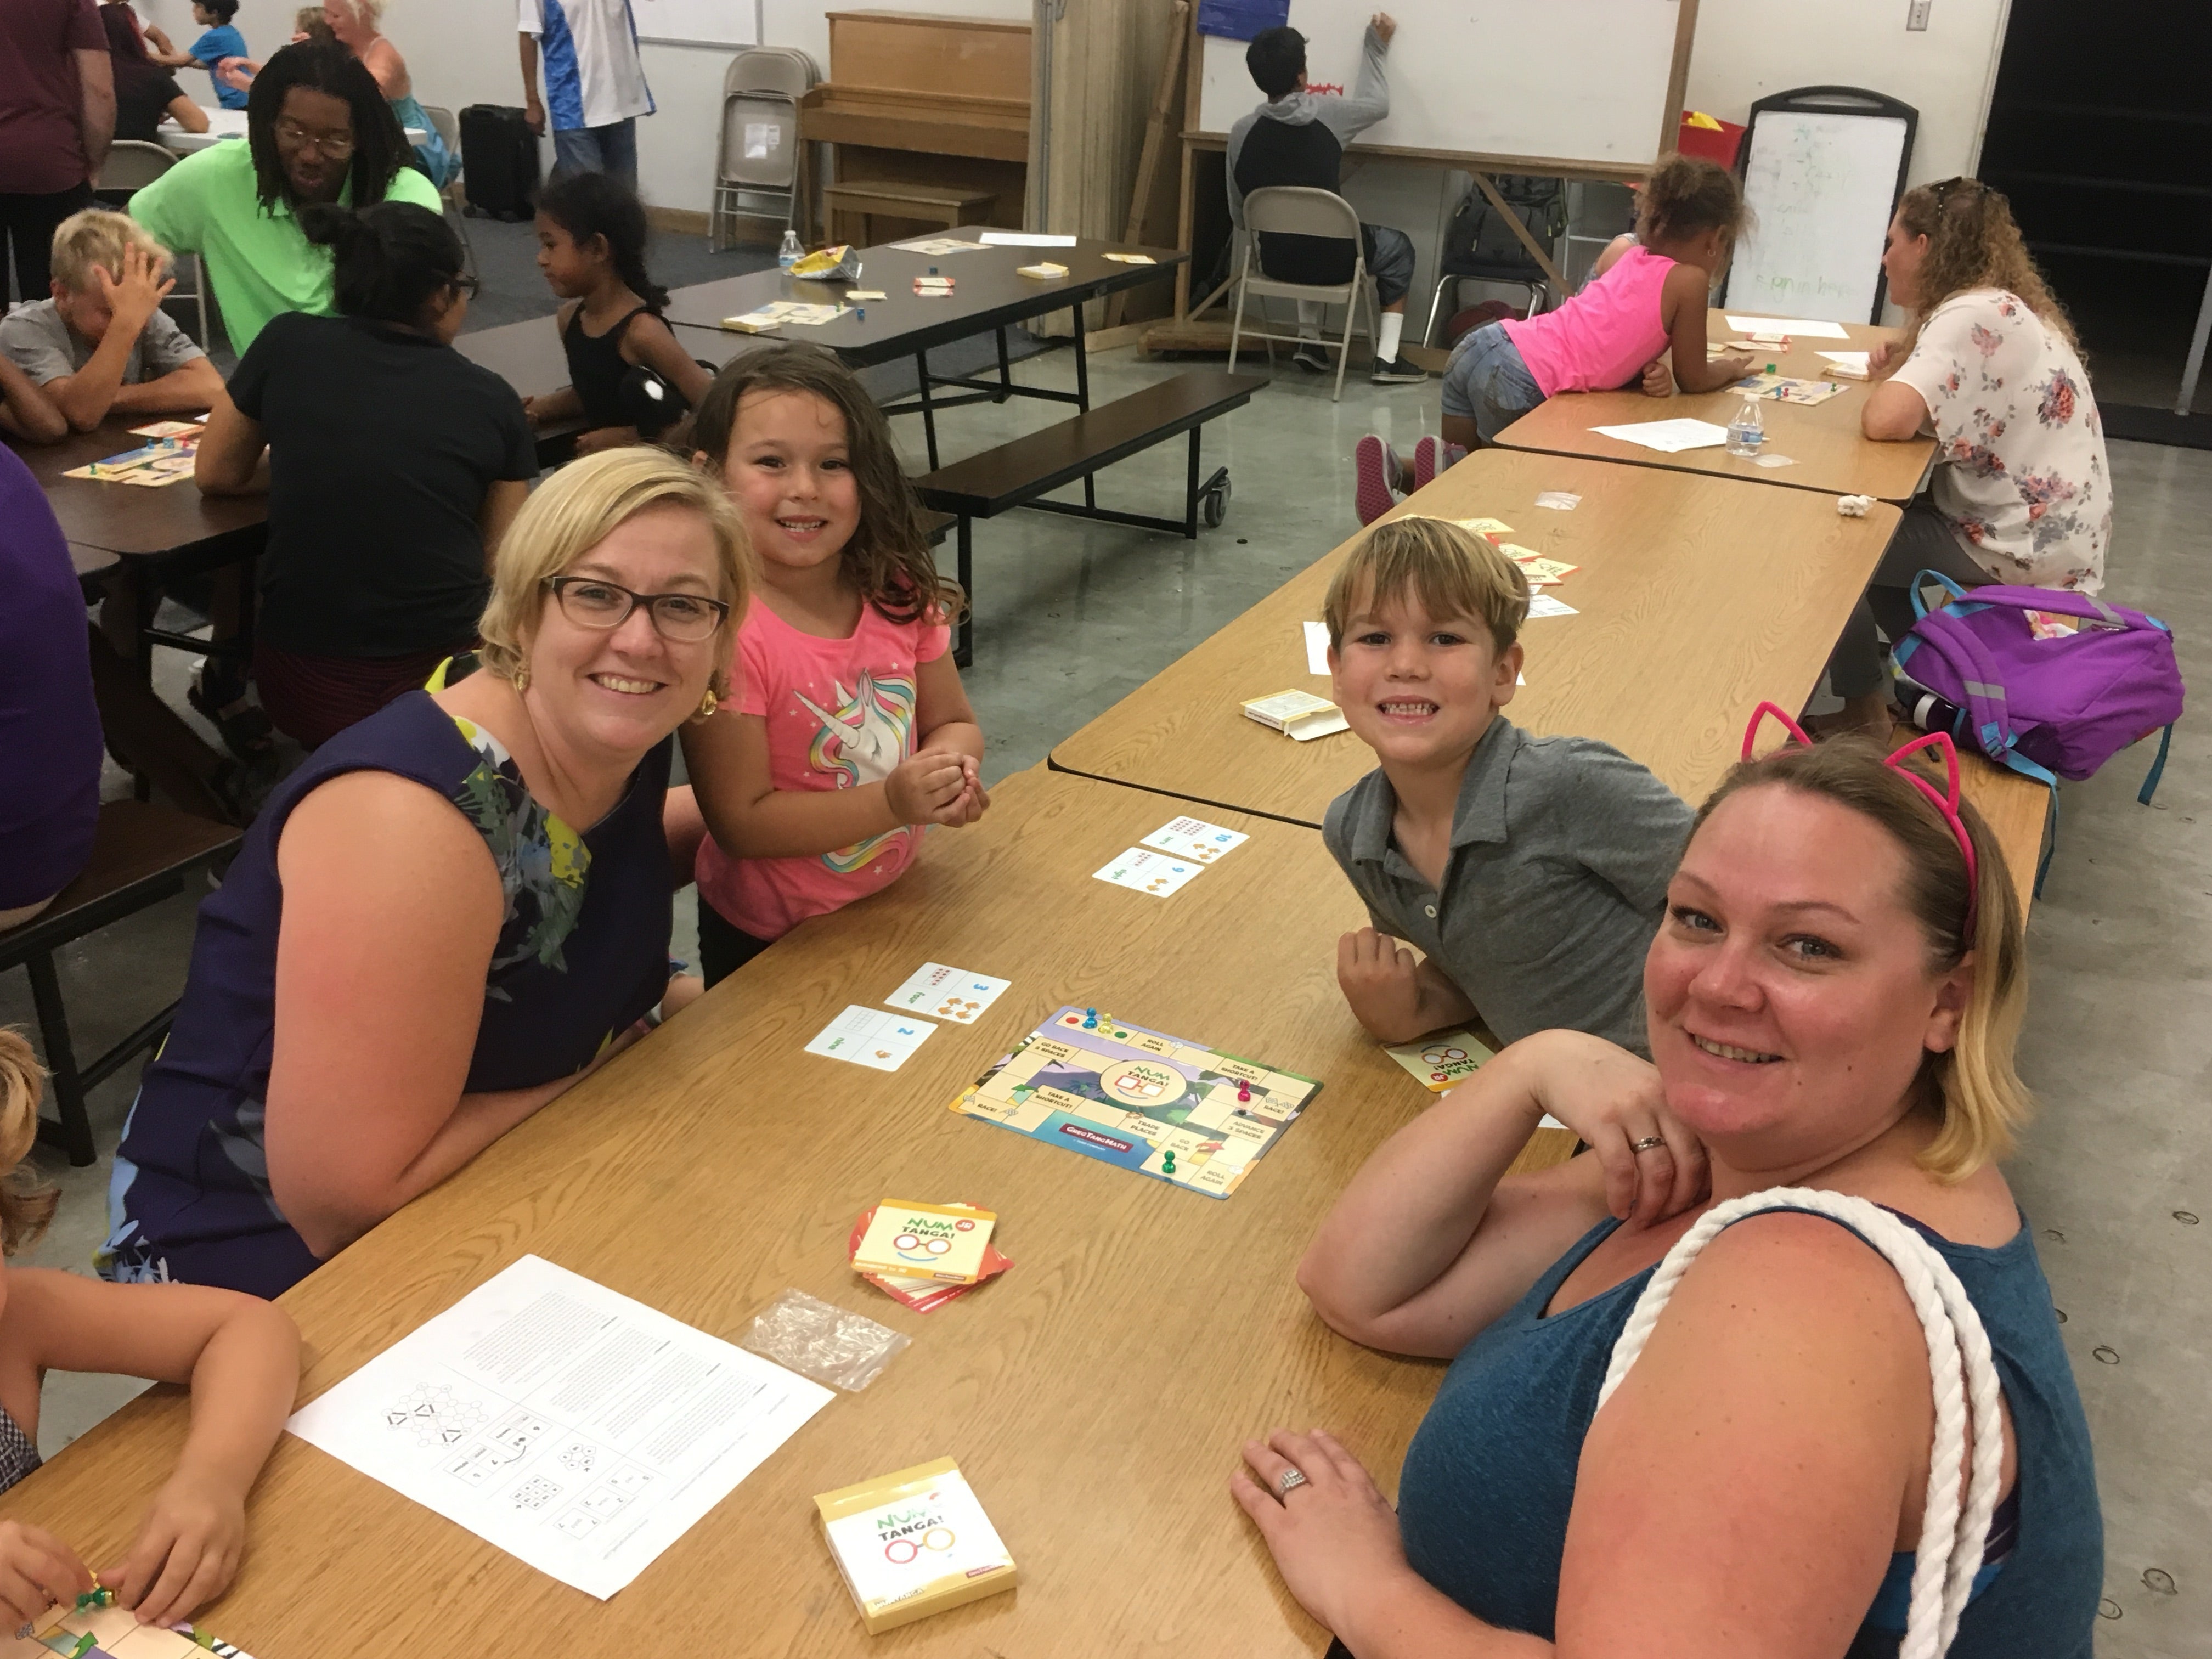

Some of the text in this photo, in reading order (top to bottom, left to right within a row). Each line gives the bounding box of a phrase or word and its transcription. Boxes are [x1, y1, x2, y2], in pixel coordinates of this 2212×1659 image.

[1215, 834, 1232, 842] 10
[1111, 868, 1127, 880] eight
[907, 991, 926, 1005] four
[897, 1027, 915, 1035] 2
[828, 1037, 845, 1051] nine
[1141, 1042, 1162, 1052] AGAIN
[1147, 1039, 1164, 1047] ROLL
[1041, 1047, 1065, 1058] SPACES
[1052, 1045, 1069, 1053] BACK
[1233, 1064, 1248, 1073] TAKE
[1433, 1059, 1475, 1070] TANGA!
[1442, 1064, 1479, 1075] NUM
[1128, 1070, 1169, 1087] TANGA!
[1134, 1066, 1170, 1081] NUM
[1221, 1067, 1258, 1081] SHORTCUT!
[1048, 1091, 1064, 1099] TAKE
[1035, 1094, 1073, 1109] SHORTCUT!
[977, 1103, 997, 1113] RACE!
[1263, 1105, 1285, 1114] RACE!
[1130, 1125, 1157, 1136] PLACES
[1138, 1120, 1160, 1130] TRADE
[1233, 1121, 1265, 1134] ADVANCE
[1235, 1128, 1262, 1139] SPACES
[1170, 1143, 1189, 1151] BACK
[1200, 1175, 1224, 1186] AGAIN
[1207, 1171, 1225, 1180] ROLL
[907, 1218, 953, 1231] NUM
[902, 1226, 955, 1239] TANGA!
[878, 1515, 944, 1541] TANGA!
